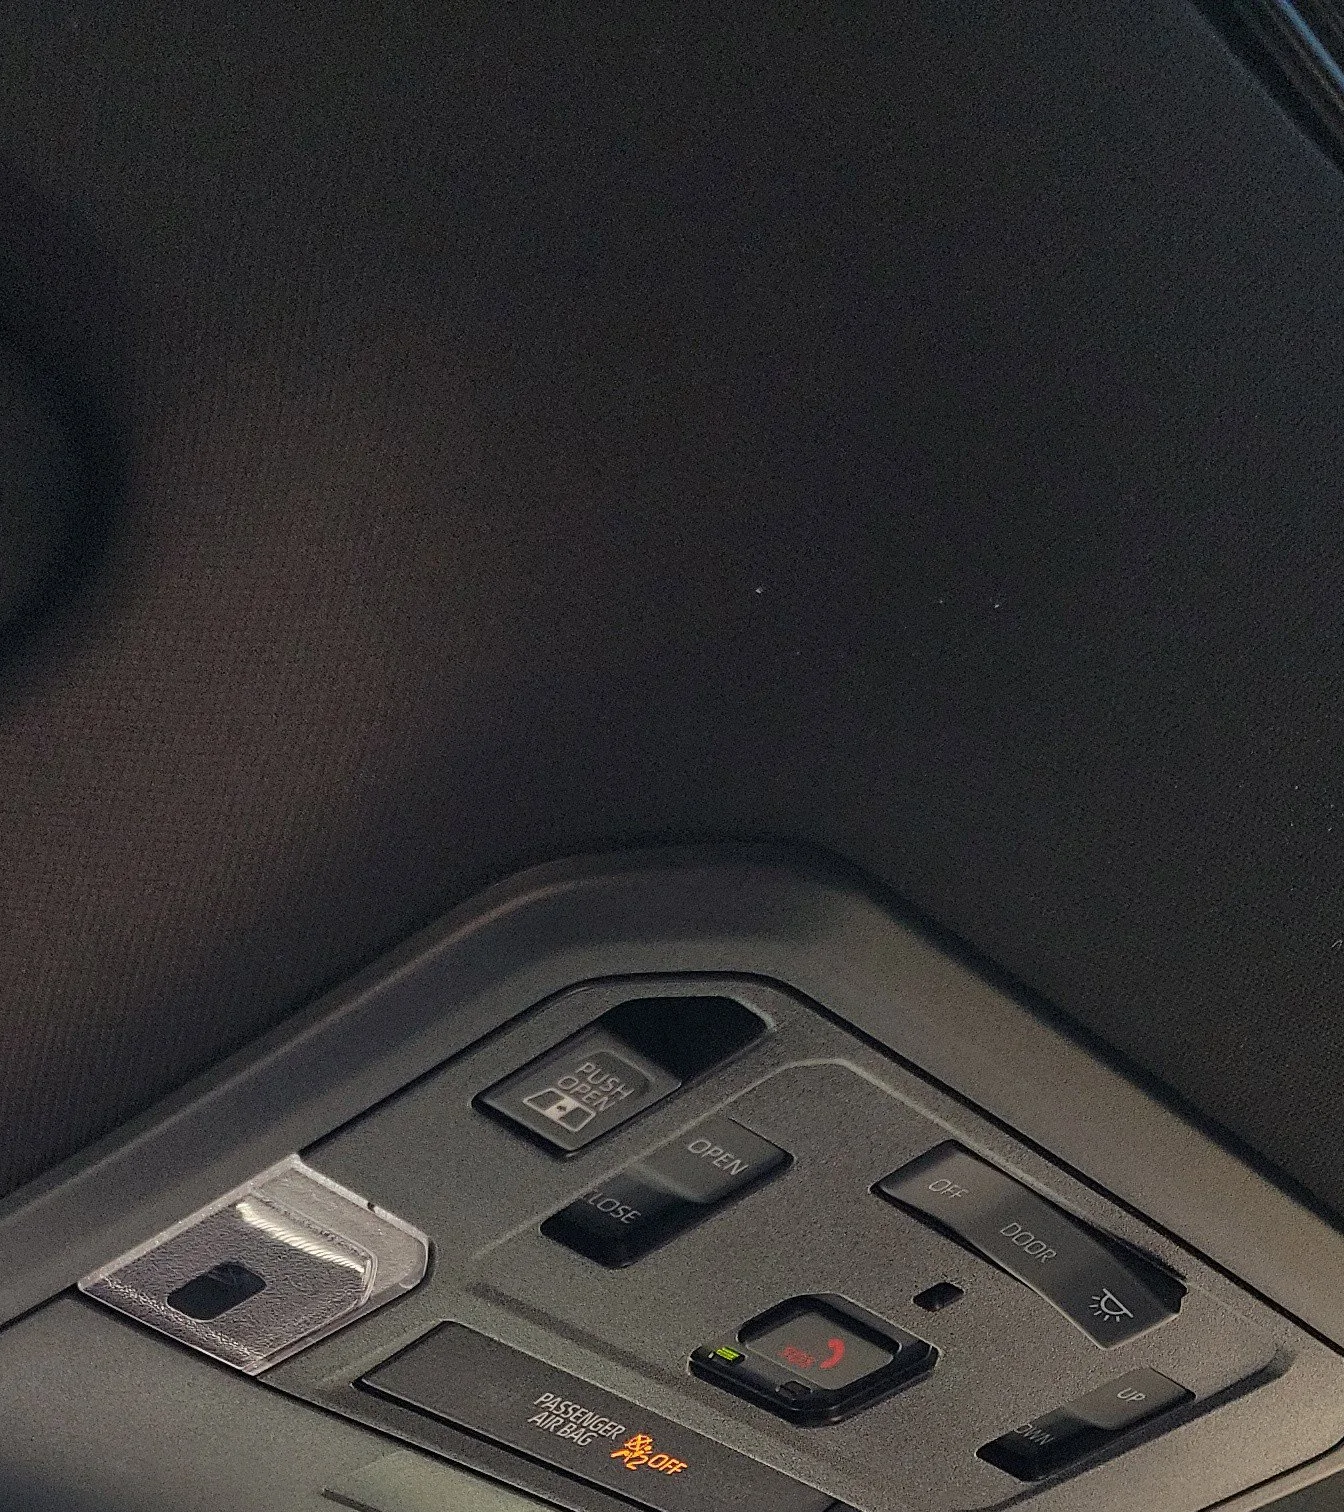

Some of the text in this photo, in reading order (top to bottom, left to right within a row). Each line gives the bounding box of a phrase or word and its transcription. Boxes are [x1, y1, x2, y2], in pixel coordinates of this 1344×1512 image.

[557, 1075, 616, 1112] OPEN
[575, 1061, 635, 1100] PUSH
[686, 1138, 749, 1177] OPEN
[927, 1176, 969, 1200] OFF
[997, 1220, 1058, 1264] DOOR
[1115, 1385, 1147, 1404] UP
[527, 1410, 598, 1447] AIR BAG
[533, 1392, 626, 1440] PASSENGER
[647, 1453, 688, 1475] OFF
